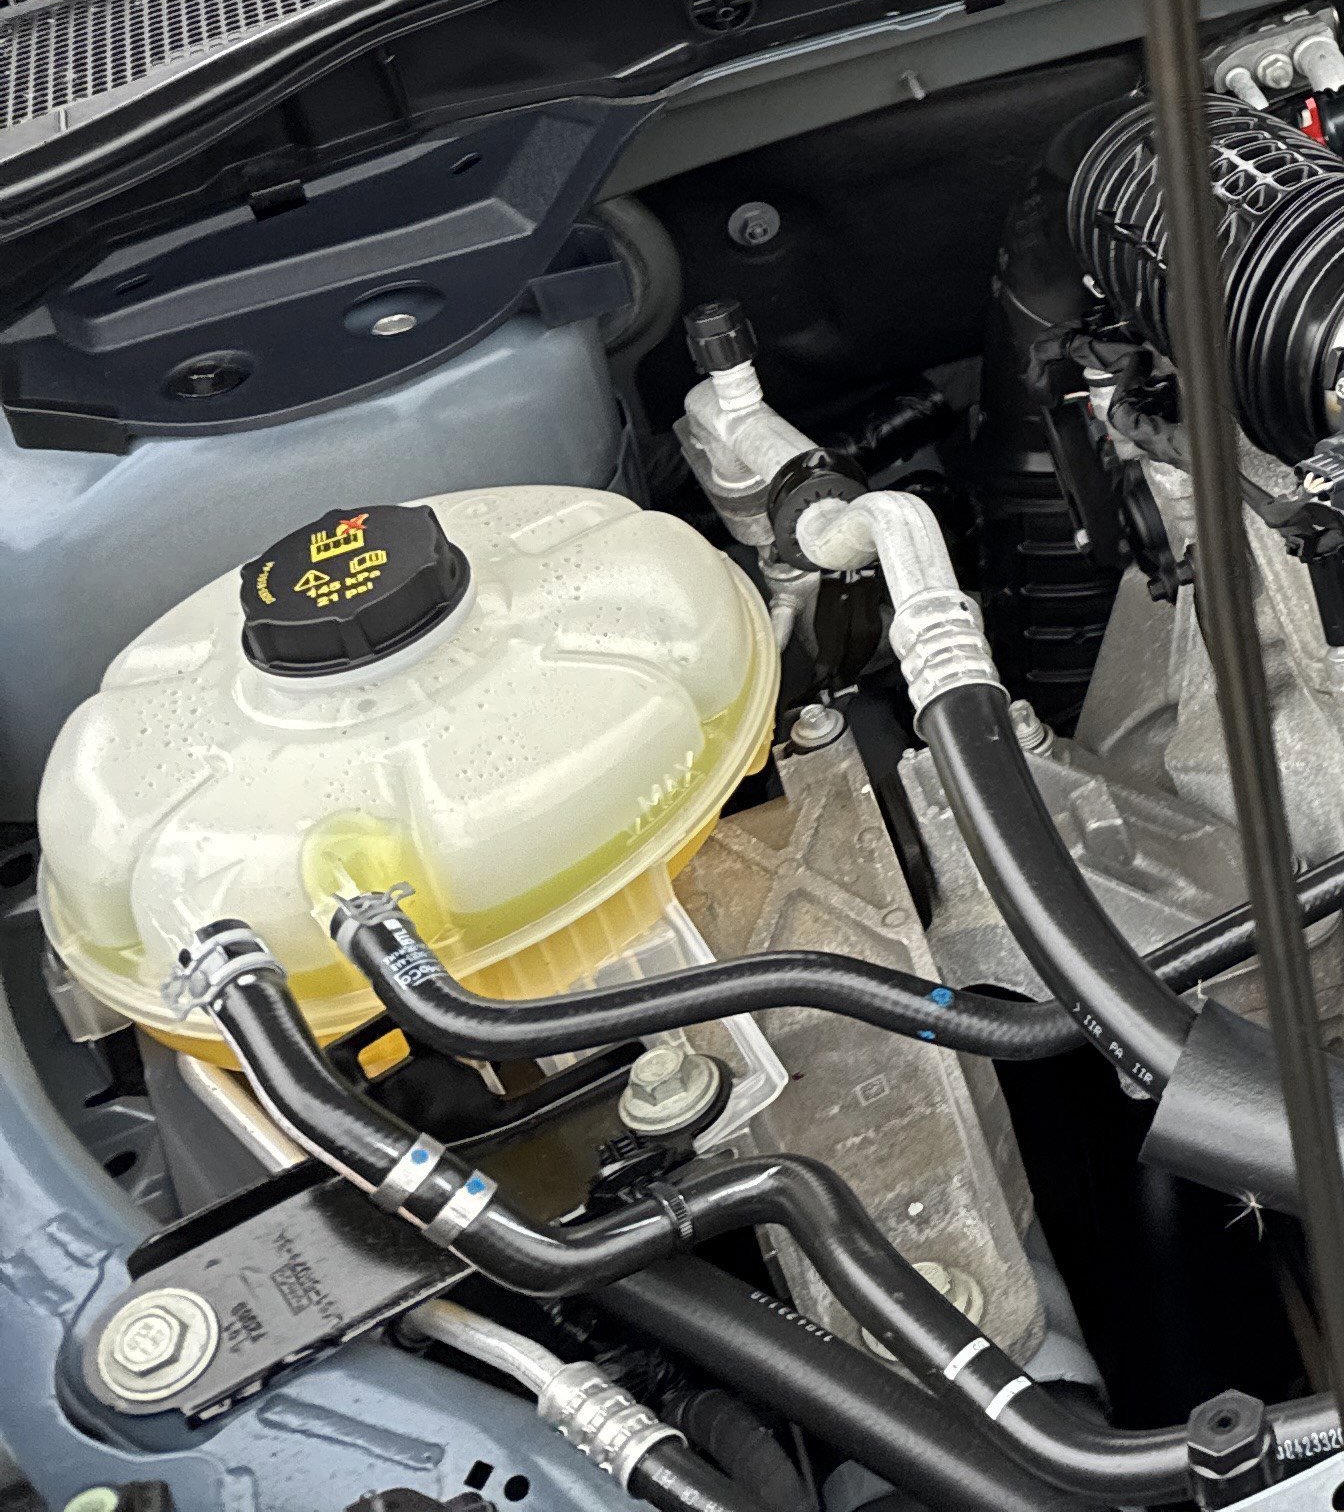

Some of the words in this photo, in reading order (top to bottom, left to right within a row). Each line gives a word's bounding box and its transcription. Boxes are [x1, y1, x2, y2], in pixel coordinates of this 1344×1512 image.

[345, 570, 381, 586] kPa
[316, 593, 339, 607] 21
[345, 581, 373, 599] psi
